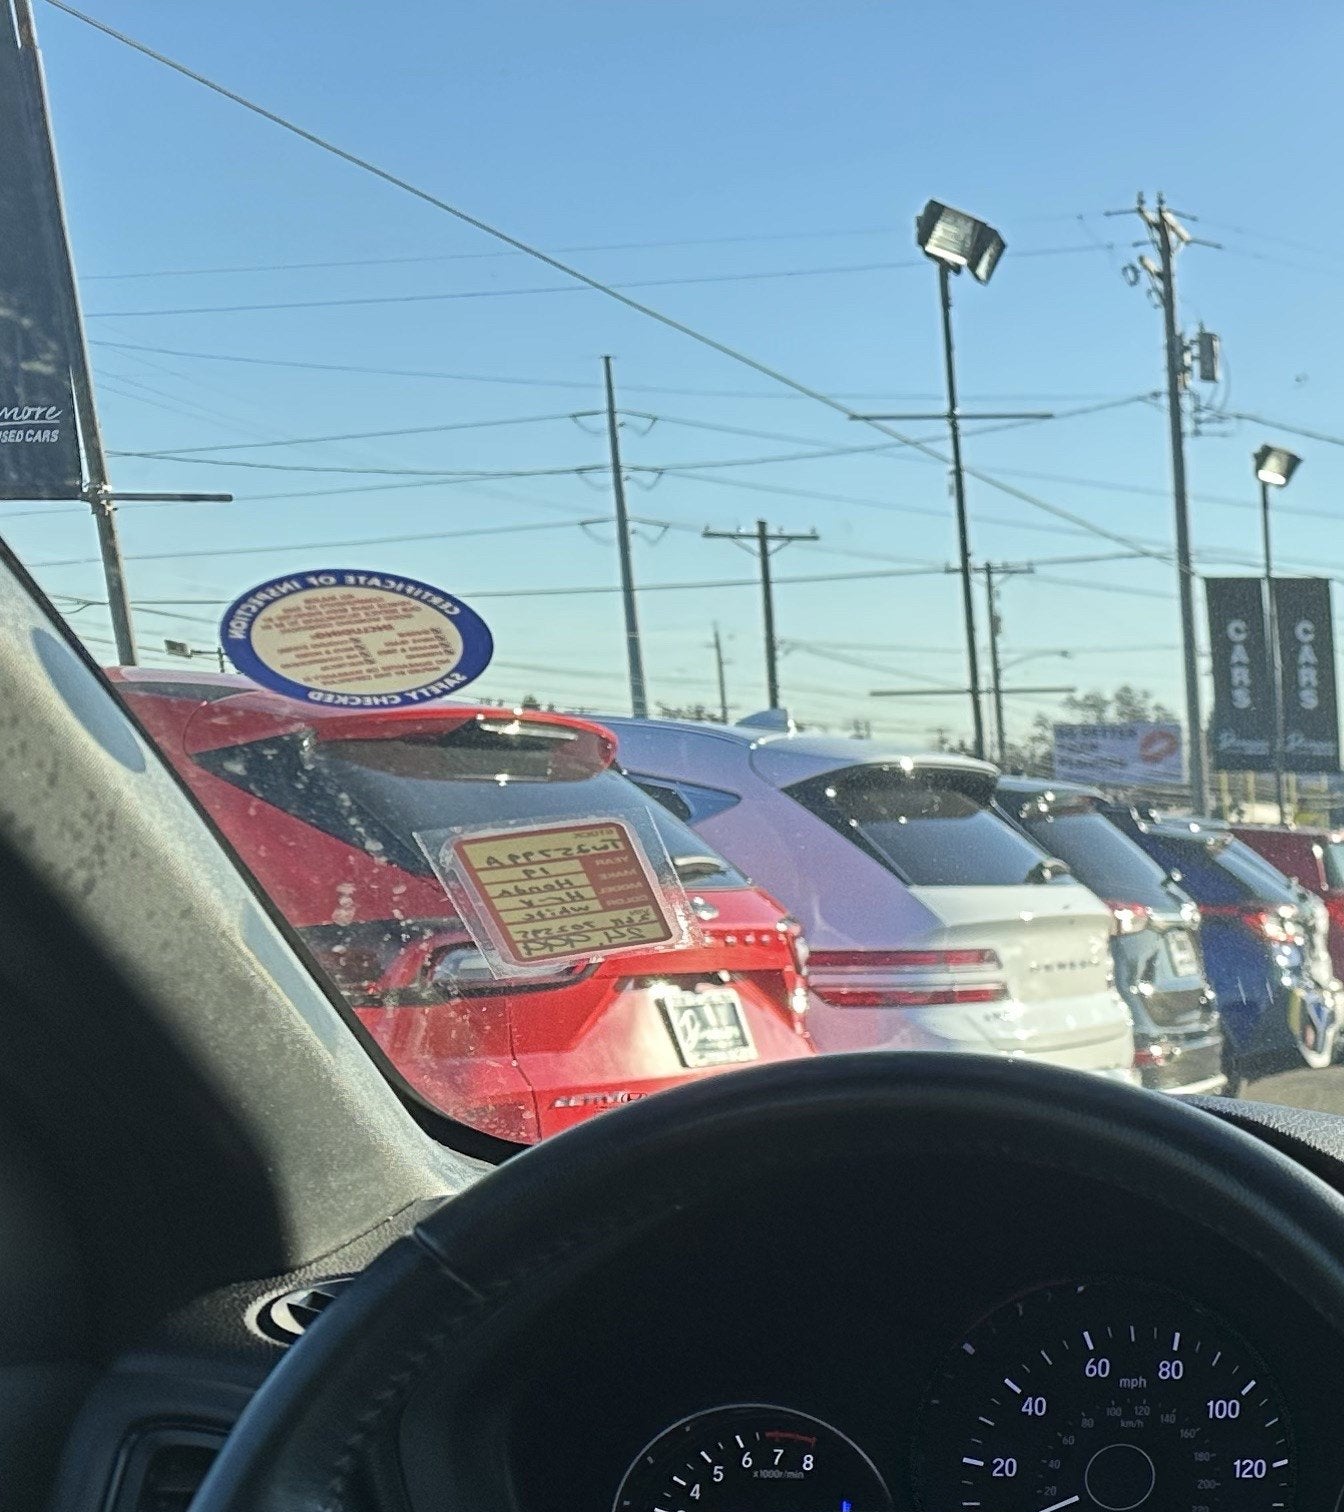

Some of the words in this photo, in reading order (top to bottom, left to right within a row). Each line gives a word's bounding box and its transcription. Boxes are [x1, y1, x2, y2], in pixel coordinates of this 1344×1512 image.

[0, 430, 24, 443] SED
[26, 429, 60, 443] CARS
[1226, 619, 1252, 709] CARS
[1294, 619, 1319, 710] CARS
[1085, 1359, 1110, 1378] 60
[1159, 1361, 1183, 1380] 80
[1119, 1377, 1147, 1389] mph
[1021, 1397, 1047, 1416] 40
[1134, 1406, 1150, 1417] 120
[1207, 1400, 1240, 1419] 100
[1120, 1419, 1144, 1429] km/h
[742, 1452, 752, 1468] 6
[773, 1449, 784, 1465] 7
[803, 1455, 814, 1471] 8
[713, 1466, 724, 1482] 5
[992, 1459, 1017, 1477] 20
[1233, 1460, 1266, 1479] 120
[690, 1484, 701, 1500] 4
